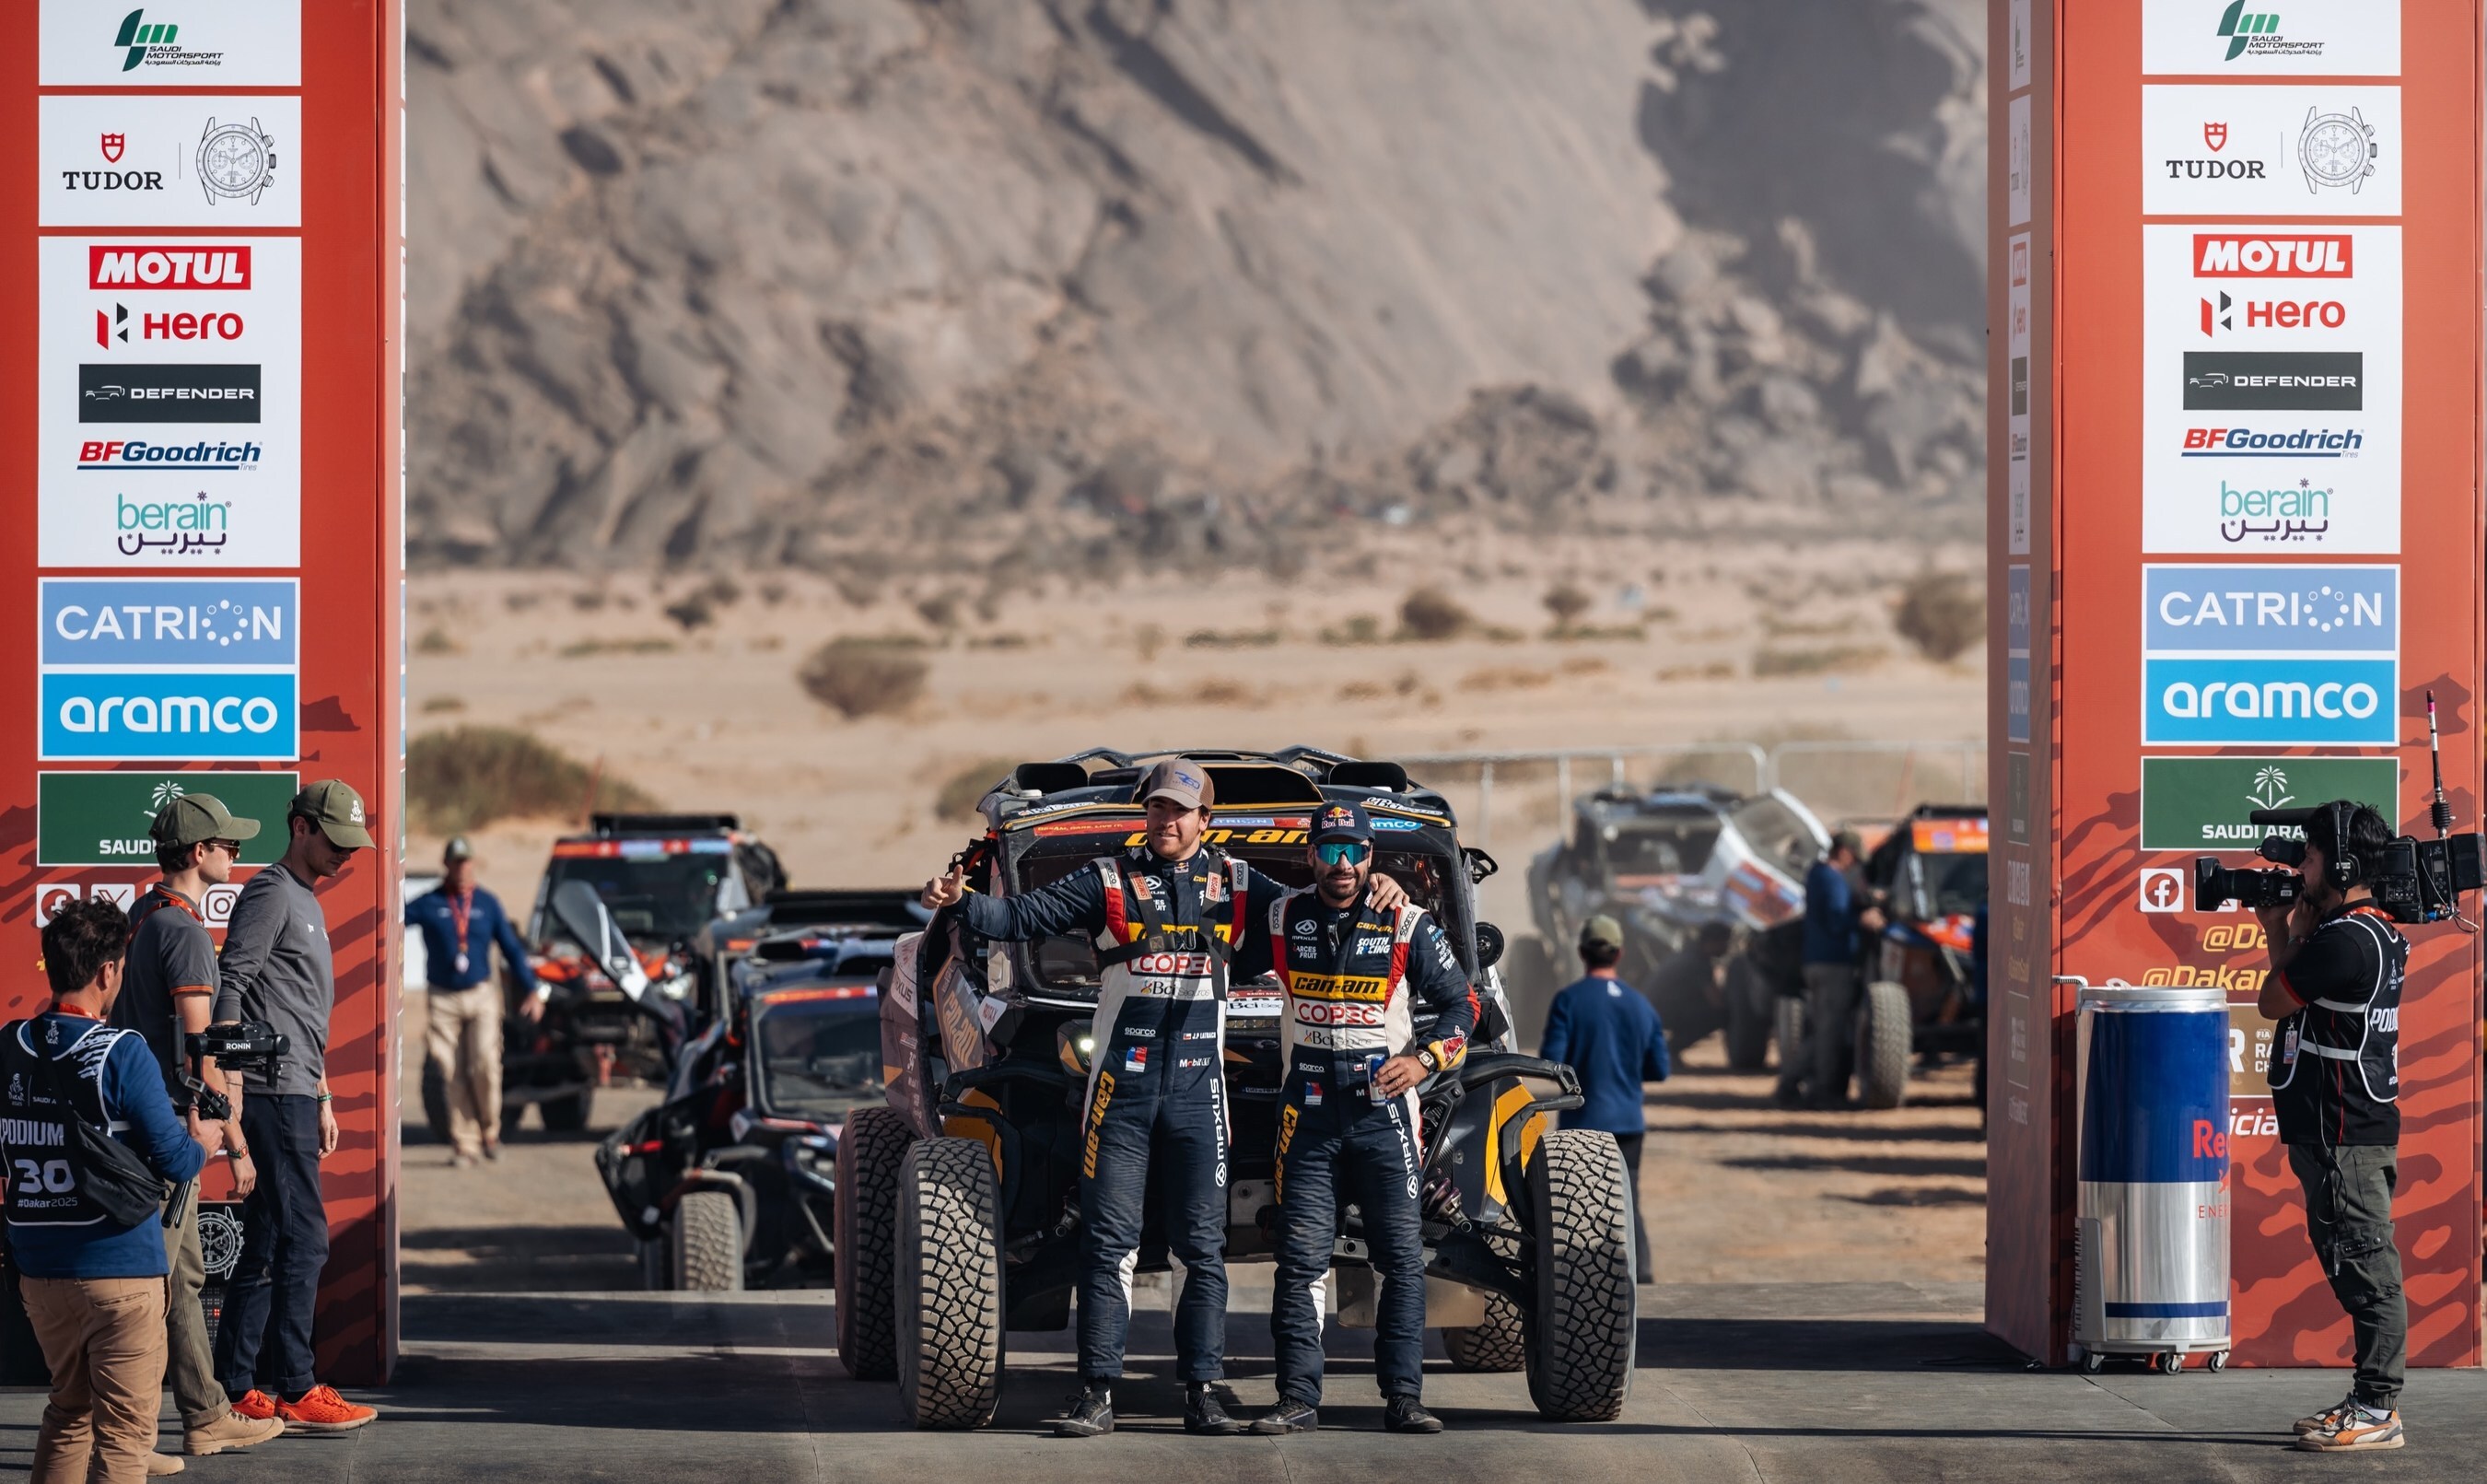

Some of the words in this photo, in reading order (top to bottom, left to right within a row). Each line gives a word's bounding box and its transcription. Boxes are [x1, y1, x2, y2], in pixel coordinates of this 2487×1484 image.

[63, 171, 163, 191] TUDOR
[2166, 160, 2266, 179] TUDOR
[97, 251, 244, 285] MOTUL
[2201, 240, 2346, 273] MOTUL
[144, 312, 244, 340] Hero
[2247, 301, 2346, 328] Hero
[2234, 375, 2356, 387] DEFENDER
[131, 388, 254, 400] DEFENDER
[2183, 428, 2363, 450] BFGoodrich
[78, 441, 262, 462] BFGoodrich
[239, 463, 258, 472] Tires
[2221, 478, 2329, 517] berain
[118, 491, 228, 531] berain
[2221, 519, 2329, 543] بيرين
[118, 532, 228, 556] بيرين
[2160, 586, 2382, 633] CATRION
[56, 600, 282, 647] CATRION
[2163, 682, 2378, 719] aramco
[59, 696, 278, 733] aramco
[1322, 819, 1337, 829] Red
[1338, 819, 1355, 827] Bull
[2201, 824, 2259, 839] SAUDI
[2264, 824, 2308, 839] ARA
[1399, 910, 1417, 936] sparco
[1358, 937, 1389, 946] SOUTH
[2203, 923, 2269, 952] @Da
[1152, 981, 1176, 995] Bci
[1294, 976, 1380, 994] can-am
[1299, 1003, 1376, 1024] COPEC
[1125, 1027, 1156, 1037] sparco
[1313, 1031, 1335, 1047] Bci
[1299, 1062, 1325, 1072] sparco
[0, 1117, 64, 1147] PODIUM
[1083, 1070, 1115, 1179] can-am
[14, 1159, 76, 1193] 30
[18, 1198, 78, 1209] #Dakar2025
